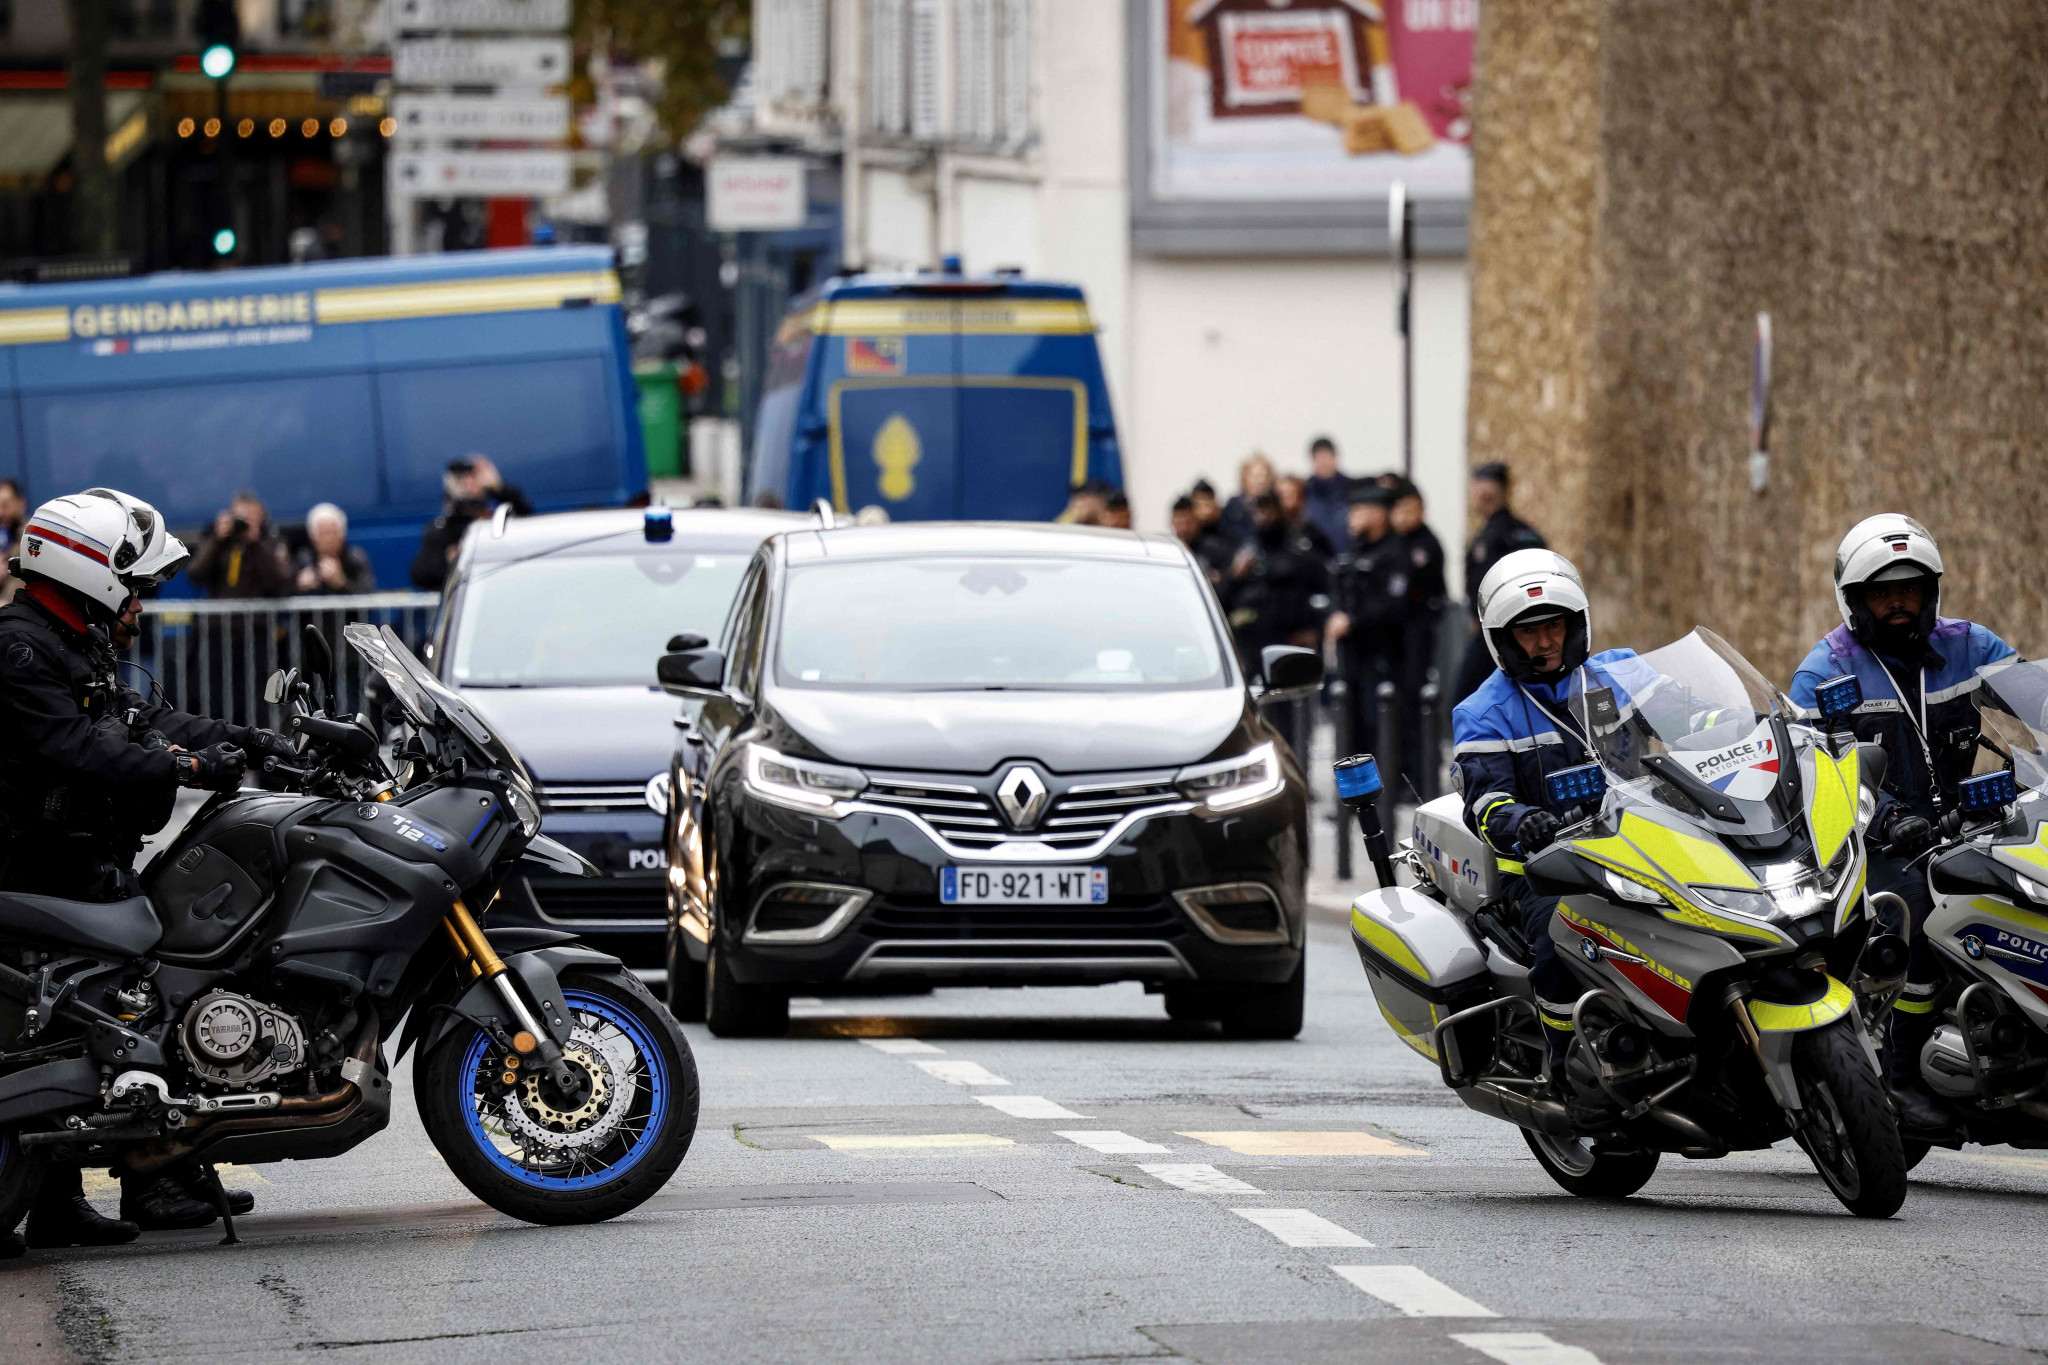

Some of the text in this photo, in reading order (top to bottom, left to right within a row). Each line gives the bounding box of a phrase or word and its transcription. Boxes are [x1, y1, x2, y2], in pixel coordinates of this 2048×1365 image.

[73, 292, 311, 337] GENDARMERIE
[1696, 743, 1755, 773] POLICE
[1702, 754, 1759, 779] NATIONALE
[396, 824, 447, 850] 1200
[961, 872, 1086, 899] FD-921-WT
[211, 1025, 241, 1034] YAMAHA
